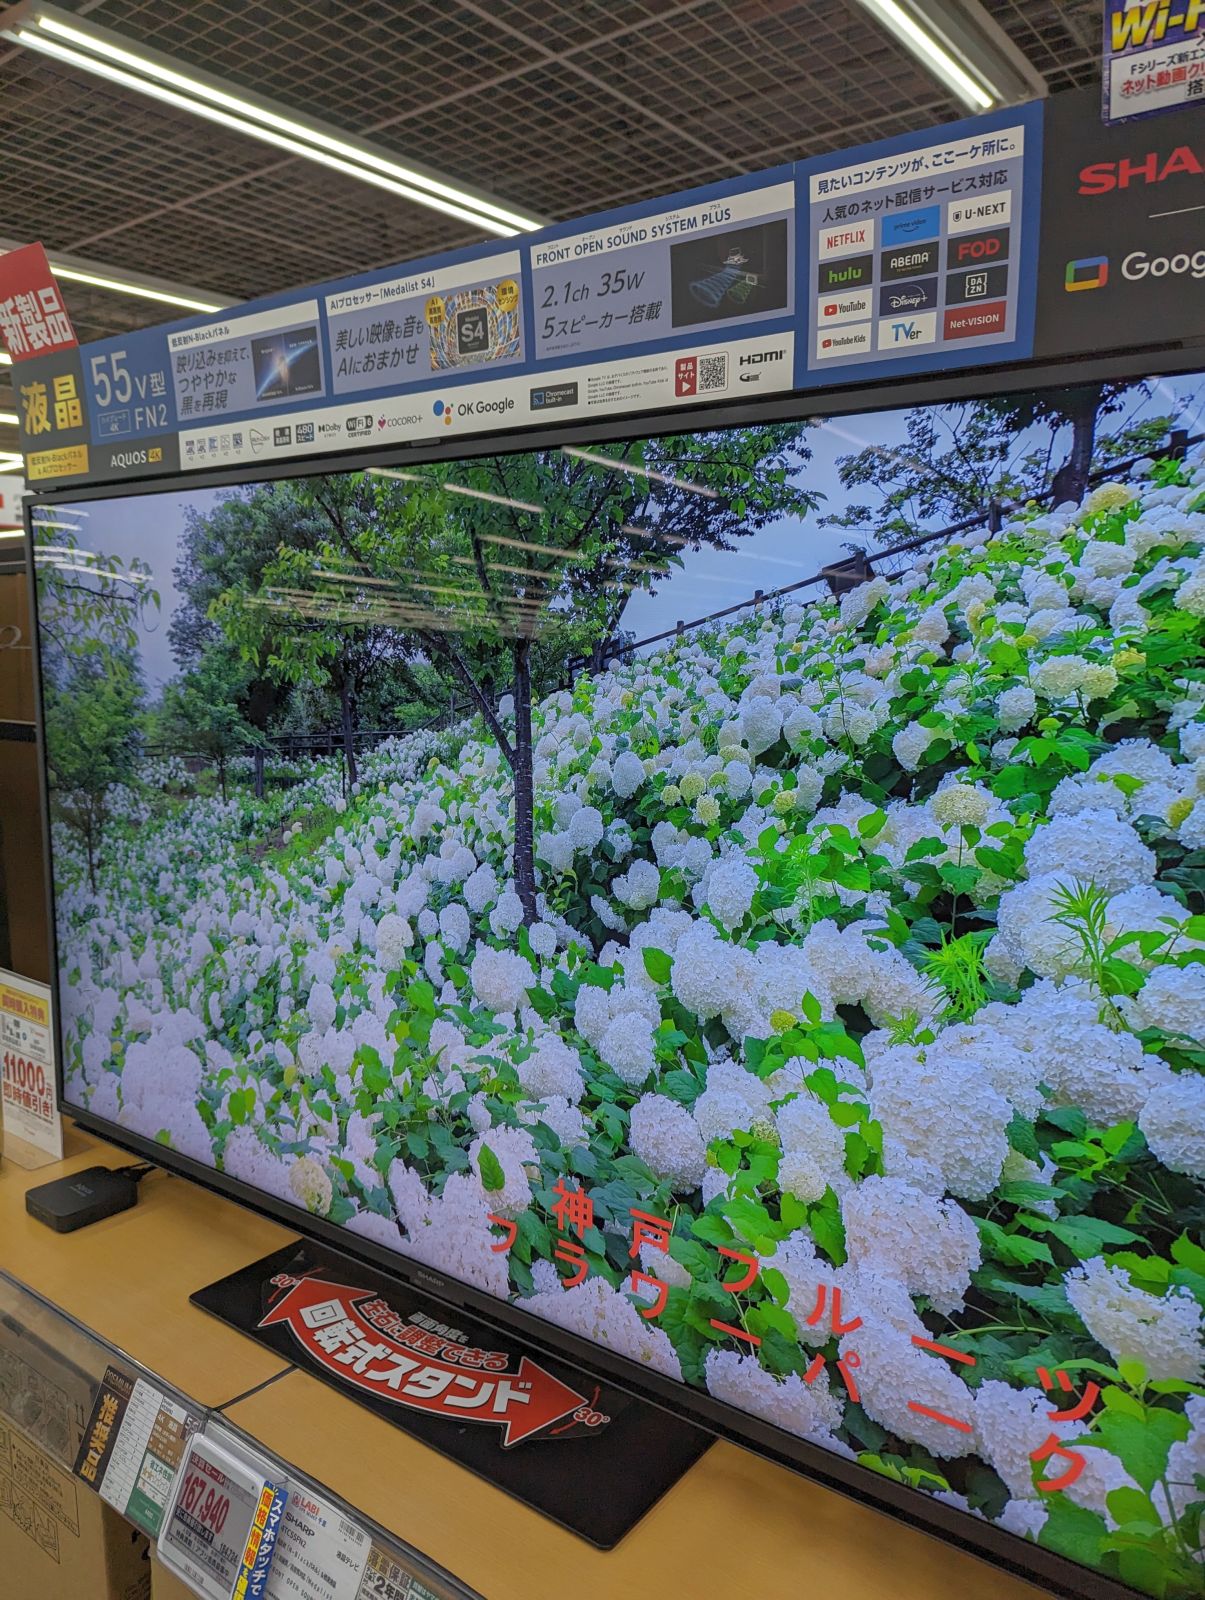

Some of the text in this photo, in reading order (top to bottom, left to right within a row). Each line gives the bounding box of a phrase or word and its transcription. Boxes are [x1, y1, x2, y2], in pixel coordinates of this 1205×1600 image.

[1078, 146, 1205, 195] SHA
[823, 169, 1008, 223] 人気のネット配信サービス対応
[965, 202, 1006, 219] U-NEXT
[536, 208, 731, 265] FRONT OPEN SOUND SYSTEM PLUS
[827, 230, 865, 249] NETFLIX
[890, 252, 929, 268] ABEMA
[958, 238, 1000, 260] FOD
[828, 267, 862, 284] hulu
[541, 281, 589, 308] 2.1ch
[838, 300, 866, 314] YouTube
[0, 287, 74, 355] 新製品
[542, 301, 662, 339] 5スピーカー搭載
[950, 314, 999, 329] Net-VISION
[336, 315, 424, 352] 美しい映像も音も
[461, 321, 484, 343] S4
[832, 334, 866, 347] YouTube Kids
[892, 322, 922, 341] TVer
[337, 344, 419, 377] AIにおまかせ
[680, 362, 694, 372] 製品
[179, 371, 237, 393] つややかな
[677, 371, 695, 381] サイト
[181, 389, 228, 415] 黒を再現
[546, 388, 574, 398] Chromecast
[21, 374, 83, 435] 液晶
[458, 397, 514, 416] OK Google
[134, 404, 168, 430] FN2
[325, 423, 341, 432] Dolby
[297, 425, 313, 433] 480
[110, 450, 147, 468] AQUOS
[359, 1299, 509, 1371] 左右に調整できる
[408, 1311, 469, 1343] 画面角度を
[299, 1299, 533, 1413] 回転式スタンド
[301, 1497, 320, 1516] LABI
[285, 1512, 315, 1538] SHARP
[251, 1499, 283, 1595] スマホタッチで
